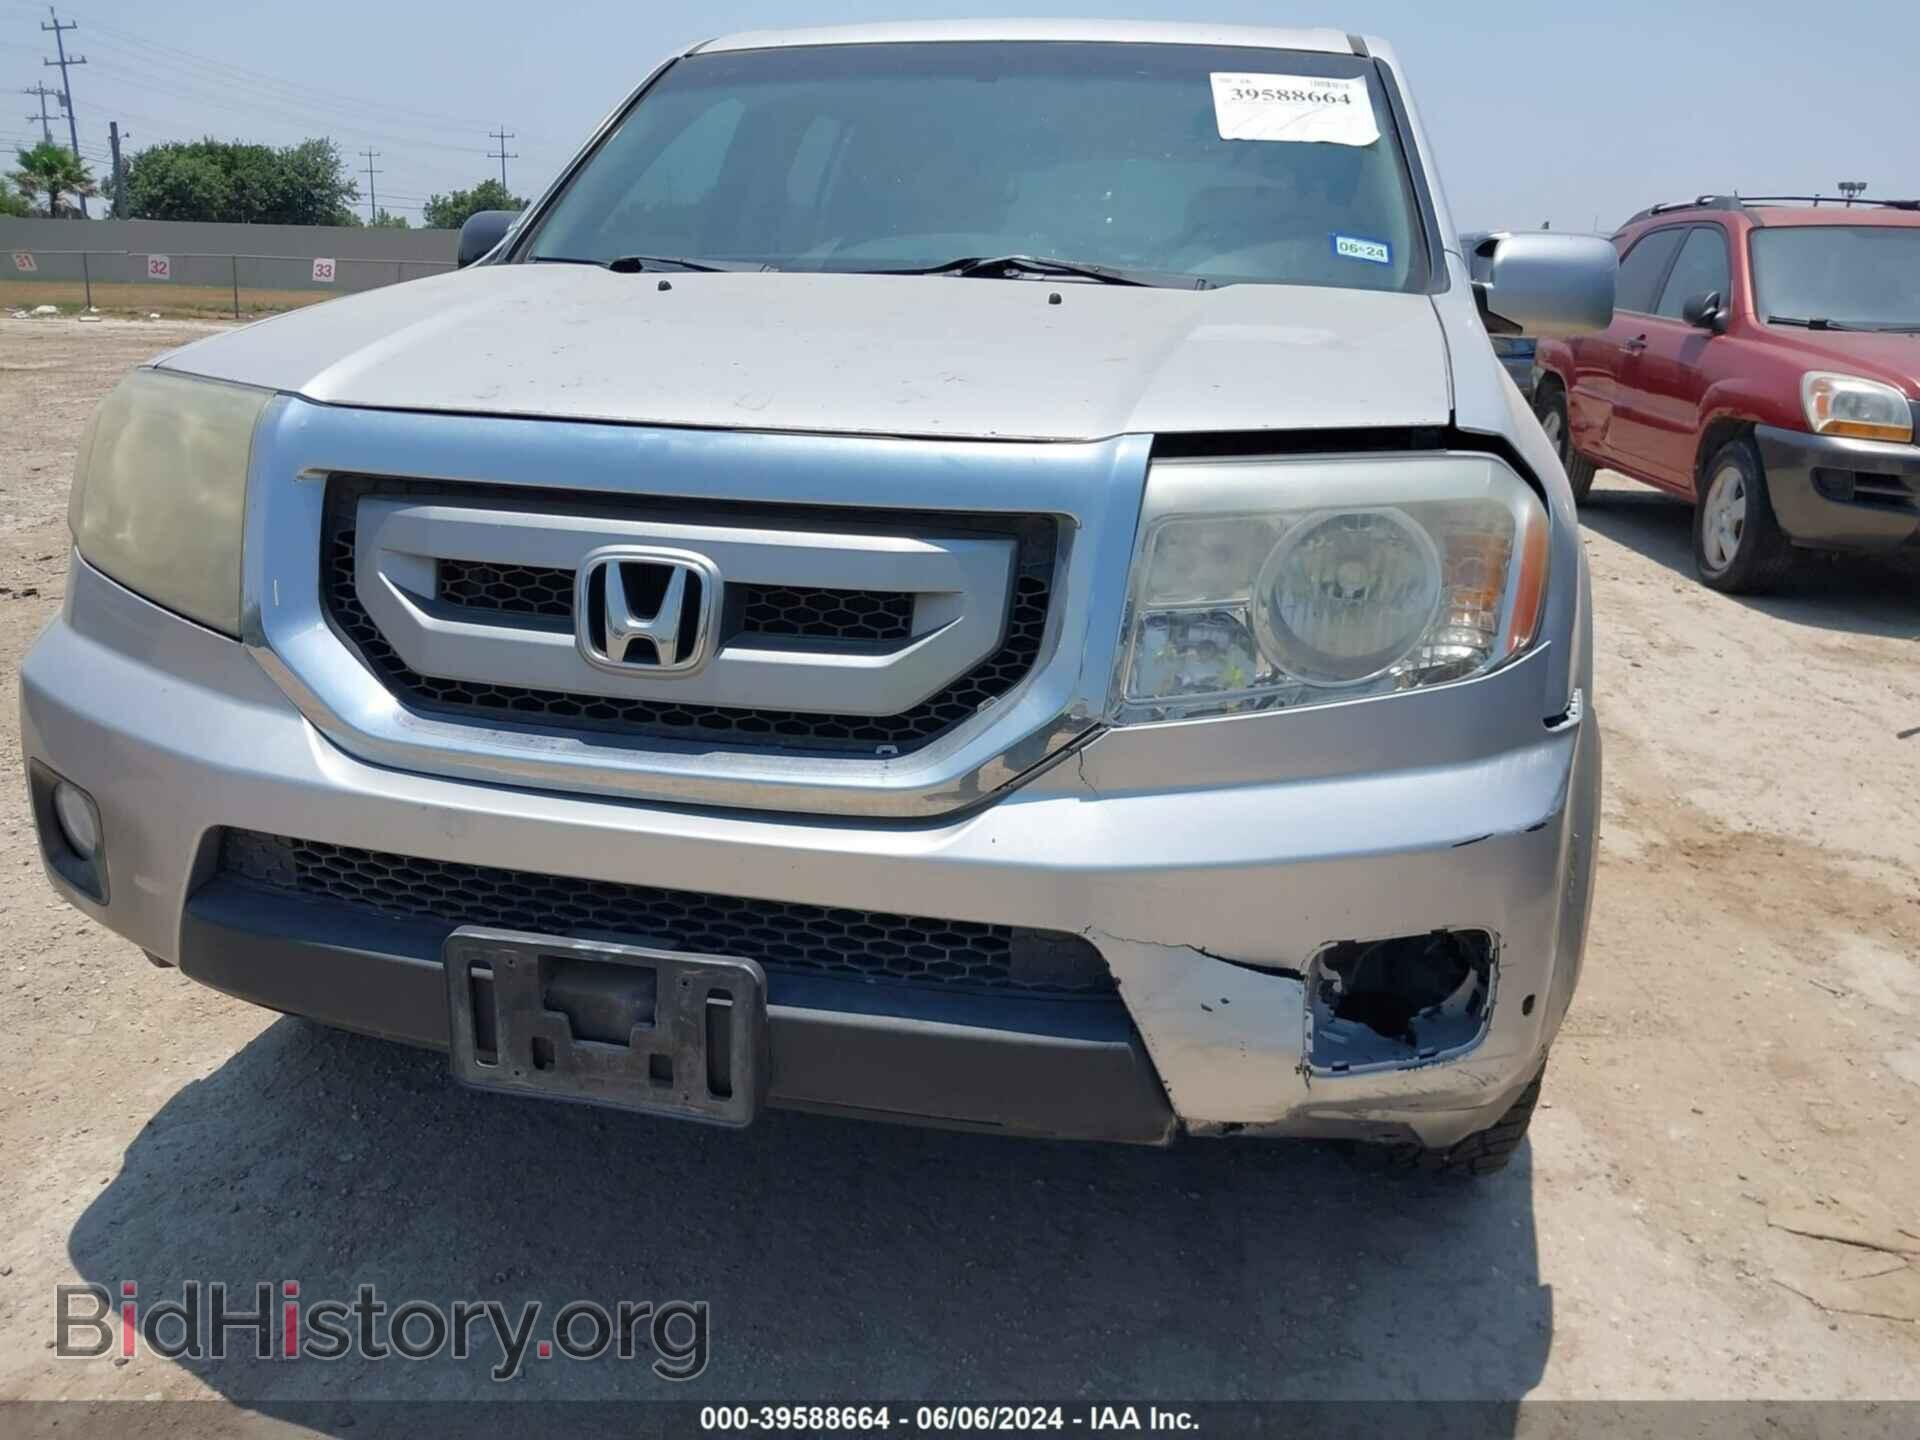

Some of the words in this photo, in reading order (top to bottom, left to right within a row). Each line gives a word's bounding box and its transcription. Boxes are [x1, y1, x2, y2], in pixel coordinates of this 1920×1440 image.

[1231, 87, 1351, 105] 39588664
[16, 251, 33, 267] 31
[150, 260, 168, 275] 32
[315, 263, 332, 278] 33
